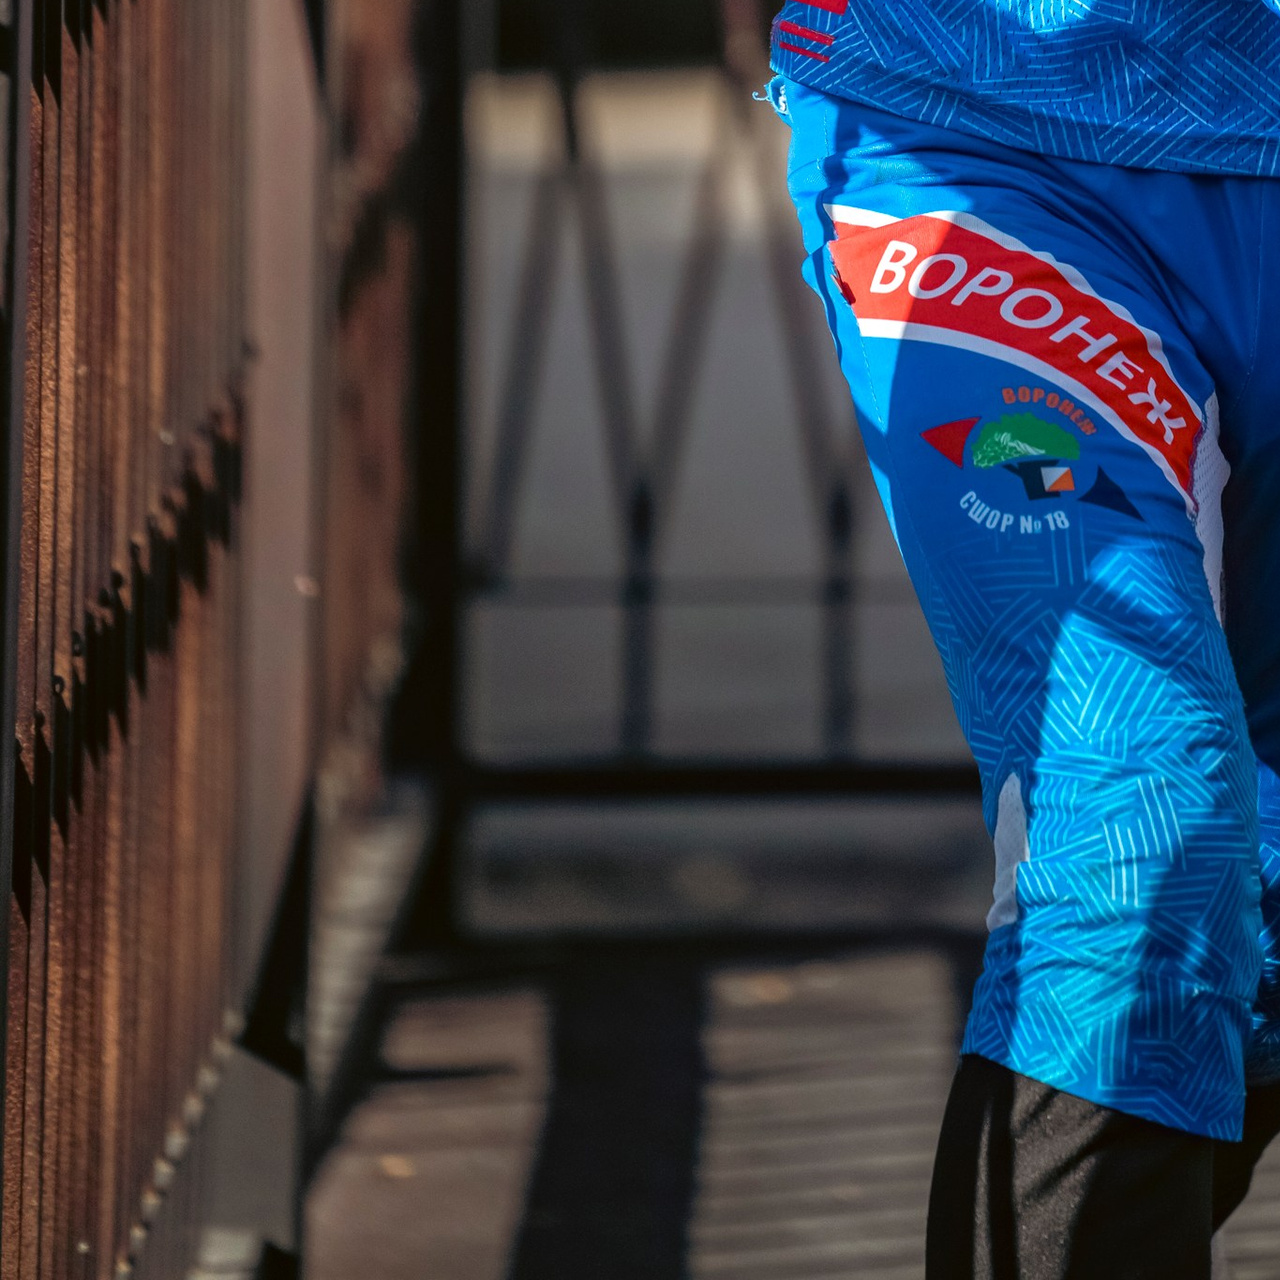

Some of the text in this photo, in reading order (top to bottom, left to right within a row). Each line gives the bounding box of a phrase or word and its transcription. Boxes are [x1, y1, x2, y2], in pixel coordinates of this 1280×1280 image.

[869, 240, 1187, 446] ВОРОНЕЖ
[1001, 386, 1097, 436] ВОРОНЕЖ
[959, 490, 1015, 533] СШОР
